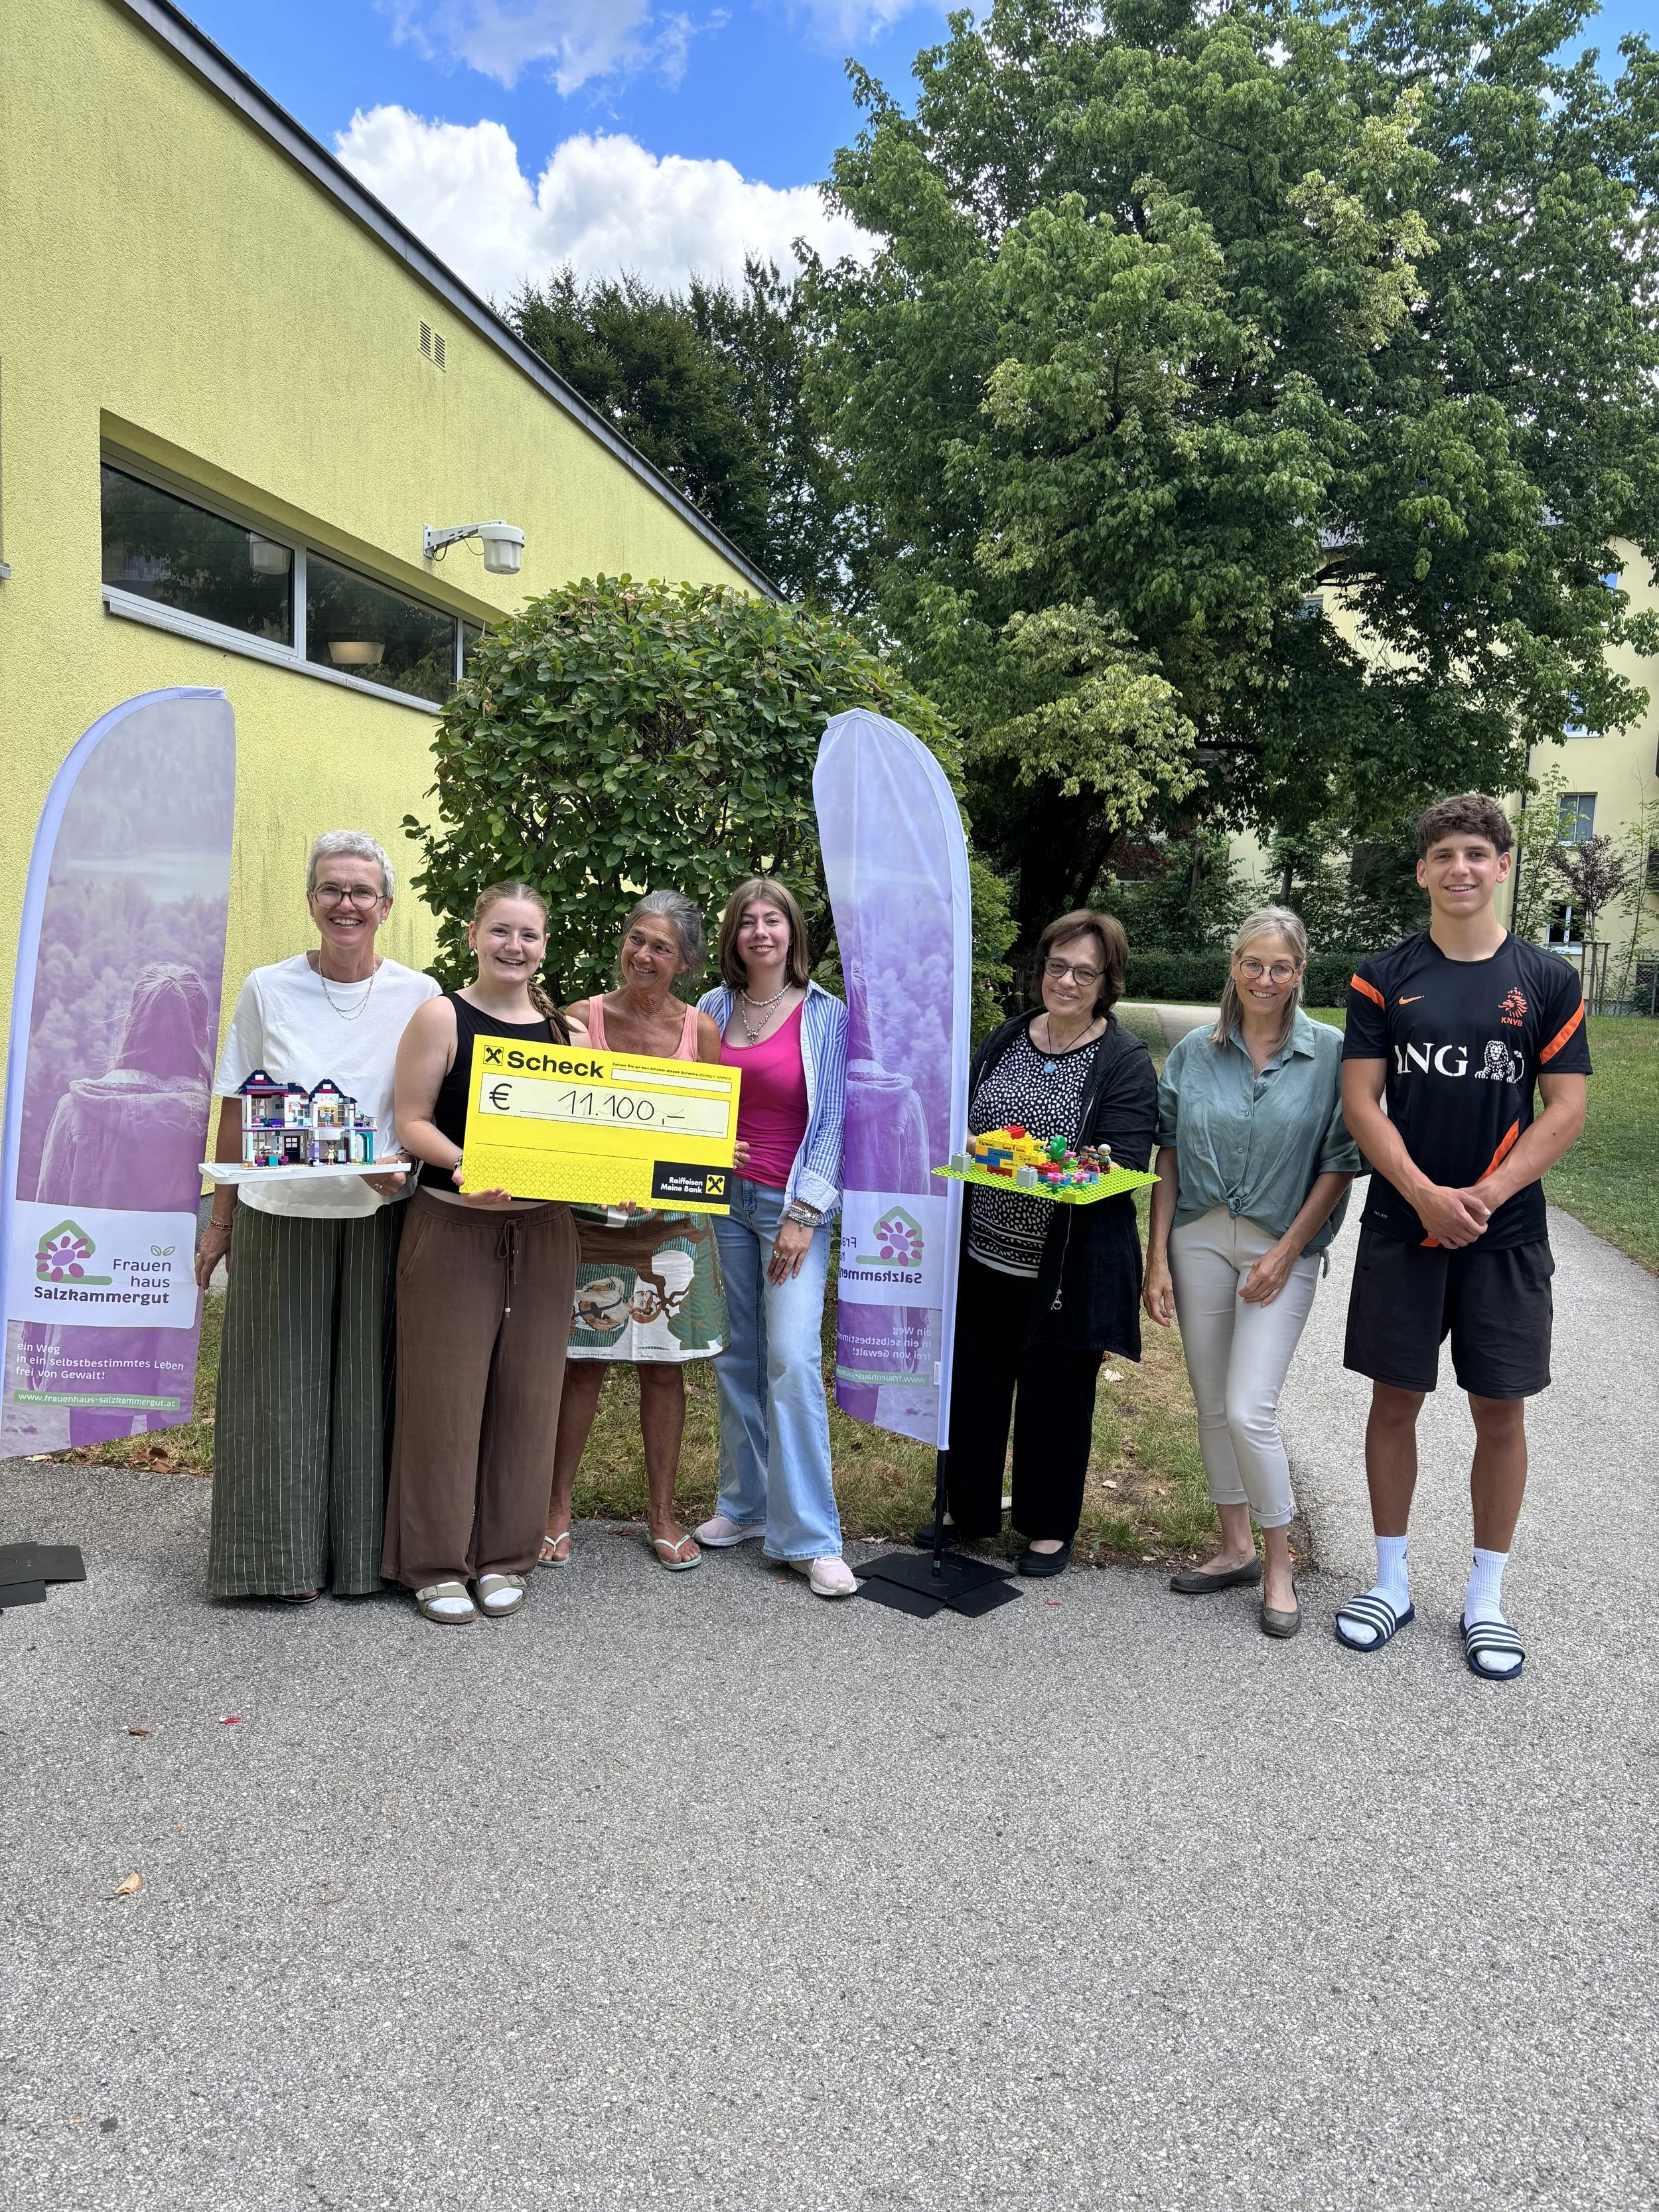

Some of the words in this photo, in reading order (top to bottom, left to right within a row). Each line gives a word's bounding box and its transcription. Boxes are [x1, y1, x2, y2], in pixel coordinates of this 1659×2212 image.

[1501, 1016, 1523, 1027] KNVB
[507, 1051, 604, 1078] Scheck
[1394, 1042, 1468, 1077] ING
[489, 1083, 513, 1110] €
[660, 1183, 682, 1193] Meine
[684, 1185, 703, 1194] Bank
[669, 1177, 703, 1187] Raiffeisen
[113, 1258, 171, 1272] Frauen
[131, 1276, 171, 1288] haus
[34, 1286, 170, 1305] Salzkammergut
[17, 1342, 34, 1353] ein
[36, 1344, 60, 1355] Weg
[17, 1355, 27, 1364] in
[29, 1356, 46, 1365] ein
[50, 1358, 151, 1368] selbstbestimmtes
[154, 1361, 184, 1371] Leben
[16, 1366, 34, 1376] frei
[37, 1369, 58, 1379] von
[61, 1370, 106, 1380] Gewalt!
[19, 1394, 176, 1408] www.frauenhaus-salzkammergut.at
